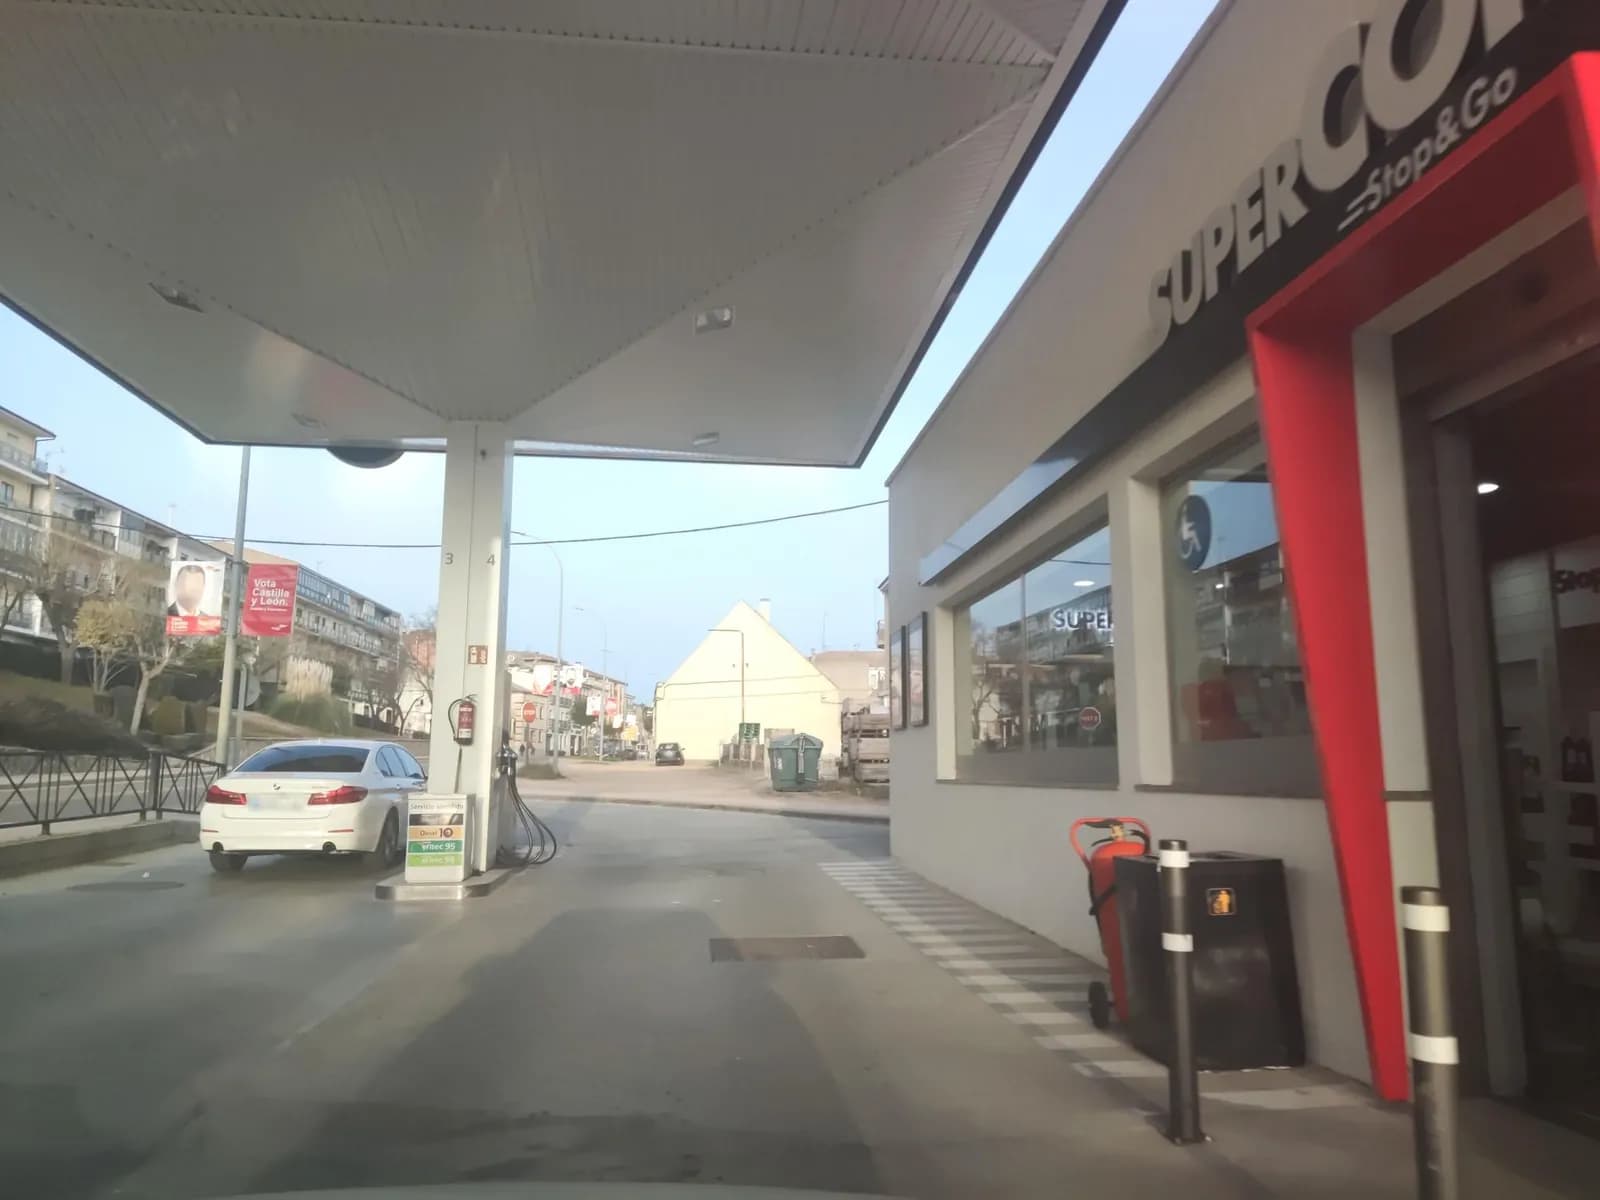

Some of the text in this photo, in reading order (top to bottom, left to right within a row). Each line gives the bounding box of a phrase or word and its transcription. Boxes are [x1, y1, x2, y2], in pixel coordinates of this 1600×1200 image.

[1358, 66, 1519, 213] Stop&Go
[1146, 0, 1525, 351] SUPERCO
[444, 552, 454, 565] 3
[486, 554, 496, 566] 4
[253, 579, 277, 588] Vota
[252, 588, 290, 597] Castilla
[250, 598, 258, 607] y
